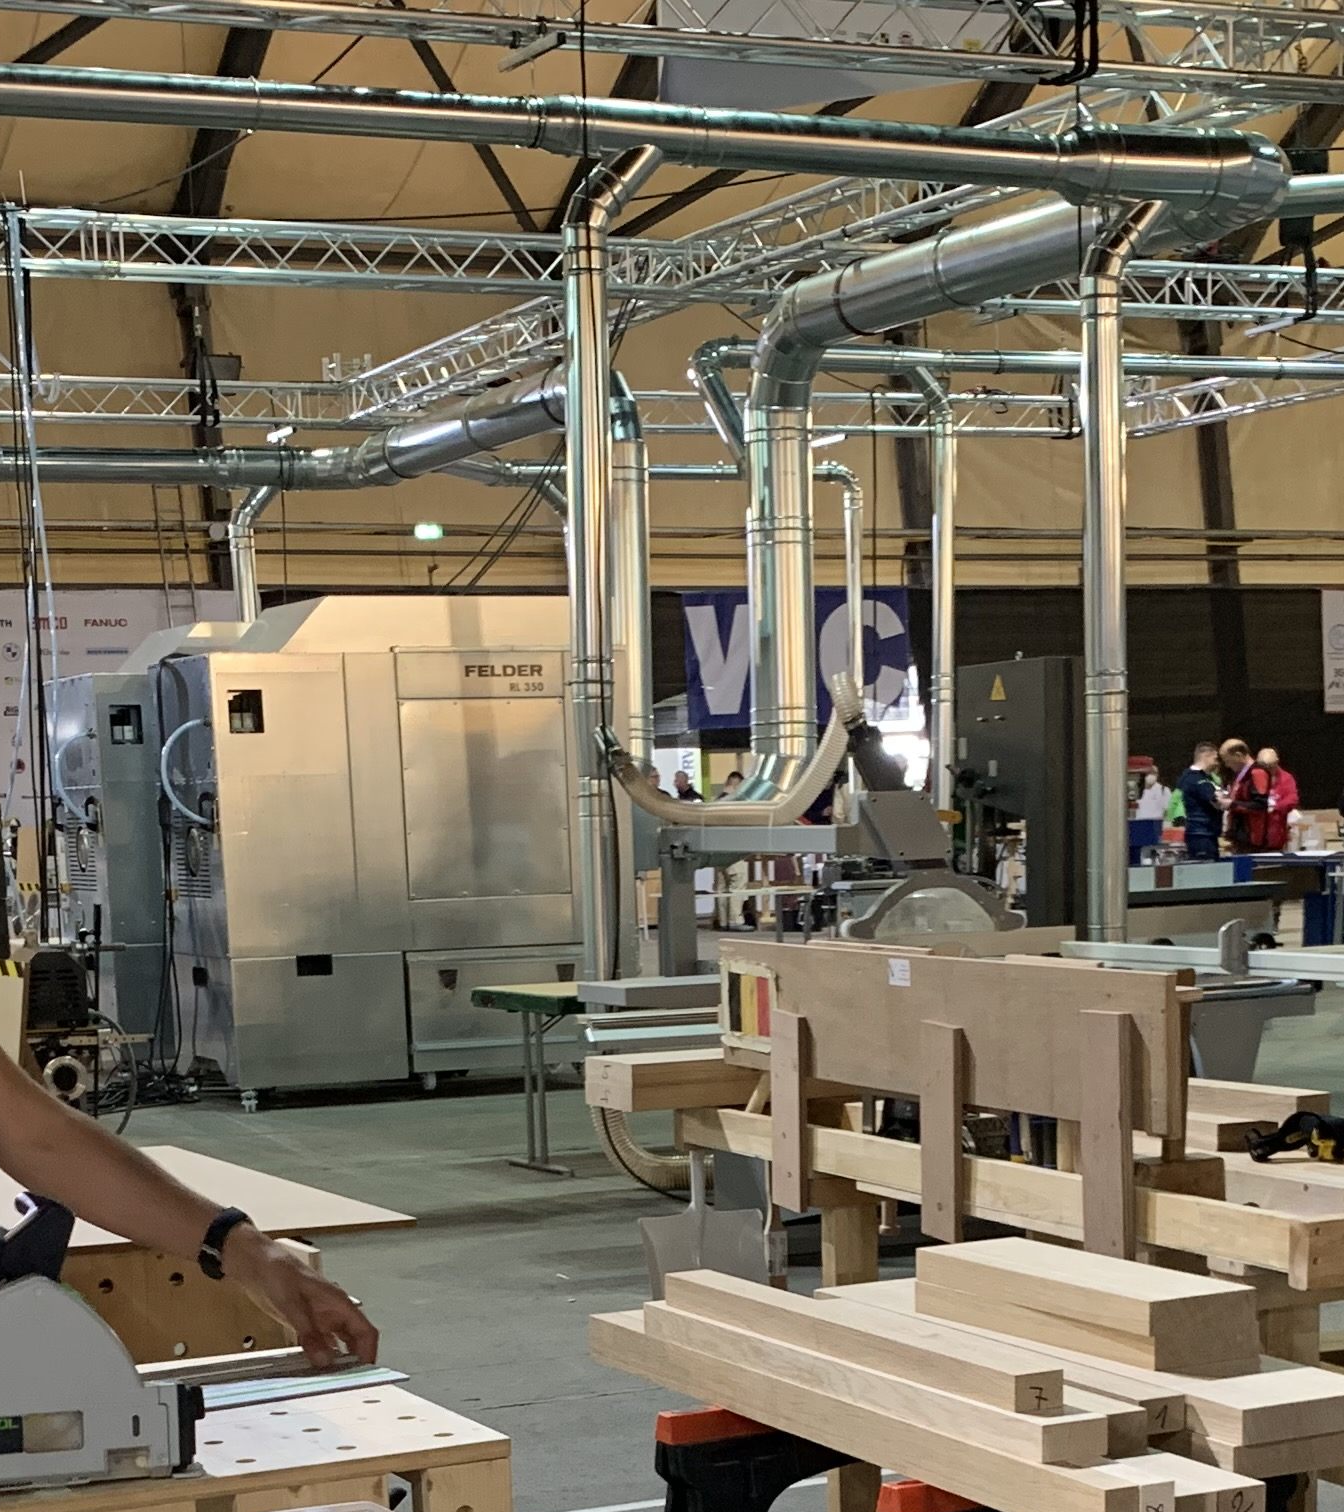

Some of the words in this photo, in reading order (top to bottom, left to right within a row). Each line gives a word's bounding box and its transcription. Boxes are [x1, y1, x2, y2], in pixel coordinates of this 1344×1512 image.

[464, 664, 543, 677] FELDER
[523, 682, 544, 692] 350
[1029, 1386, 1048, 1411] 7
